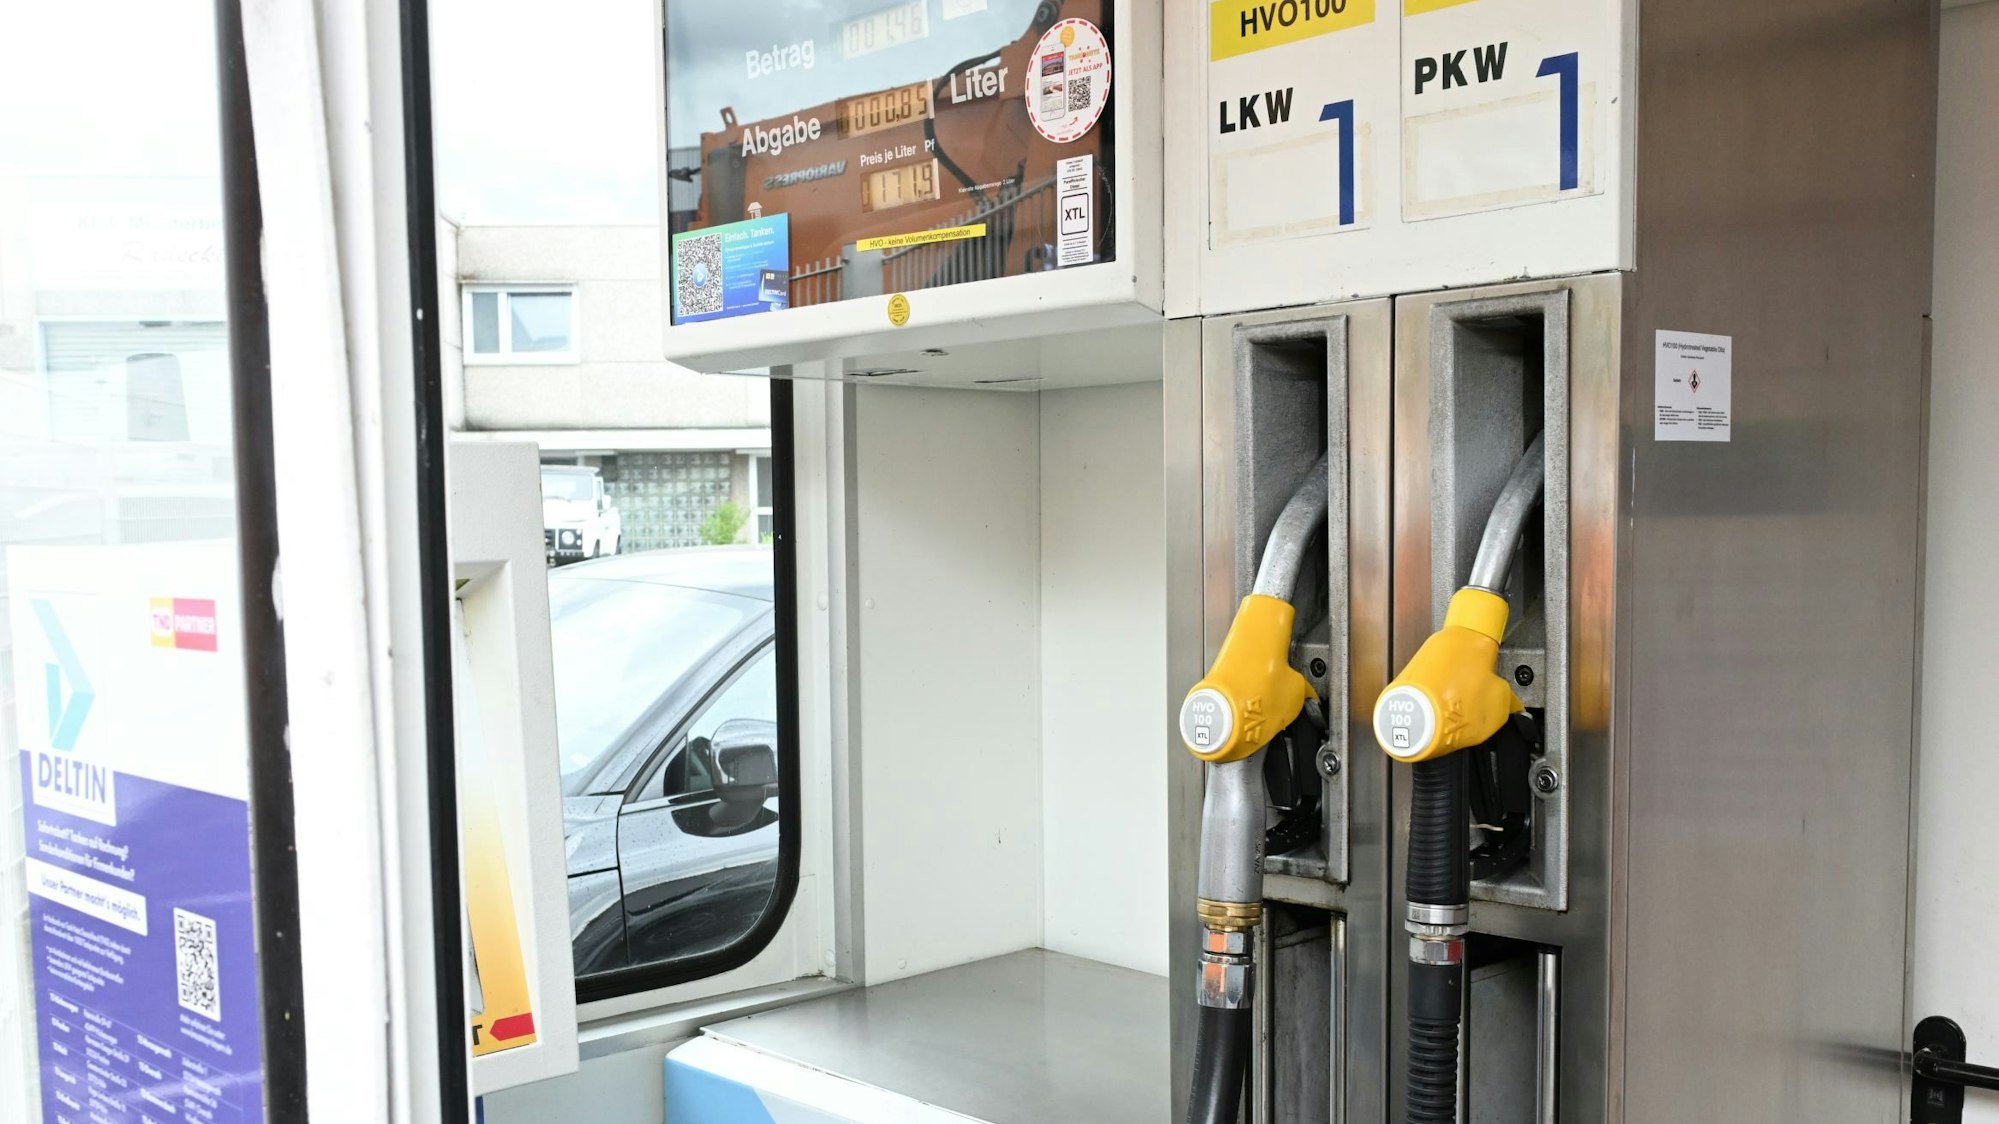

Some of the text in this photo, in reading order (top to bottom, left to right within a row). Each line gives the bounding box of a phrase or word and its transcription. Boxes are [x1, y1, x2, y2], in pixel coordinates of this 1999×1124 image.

[745, 39, 815, 79] Betrag
[1414, 41, 1508, 95] PKW
[950, 66, 1008, 105] Liter
[1220, 87, 1294, 134] LKW
[1535, 51, 1579, 191] 1
[741, 116, 821, 157] Abgabe
[860, 138, 935, 167] Preis je Liter Pf
[1318, 99, 1354, 226] 1
[1065, 207, 1085, 221] XTL
[870, 239, 884, 248] HVO
[888, 237, 903, 246] keine
[905, 229, 971, 244] Volumenkompensation
[1192, 701, 1215, 713] HVO
[1194, 714, 1212, 725] 100
[1388, 700, 1415, 712] HVO
[1390, 714, 1412, 726] 100
[1197, 732, 1208, 740] XTL
[39, 752, 105, 804] DELTIN
[60, 880, 83, 899] Partner
